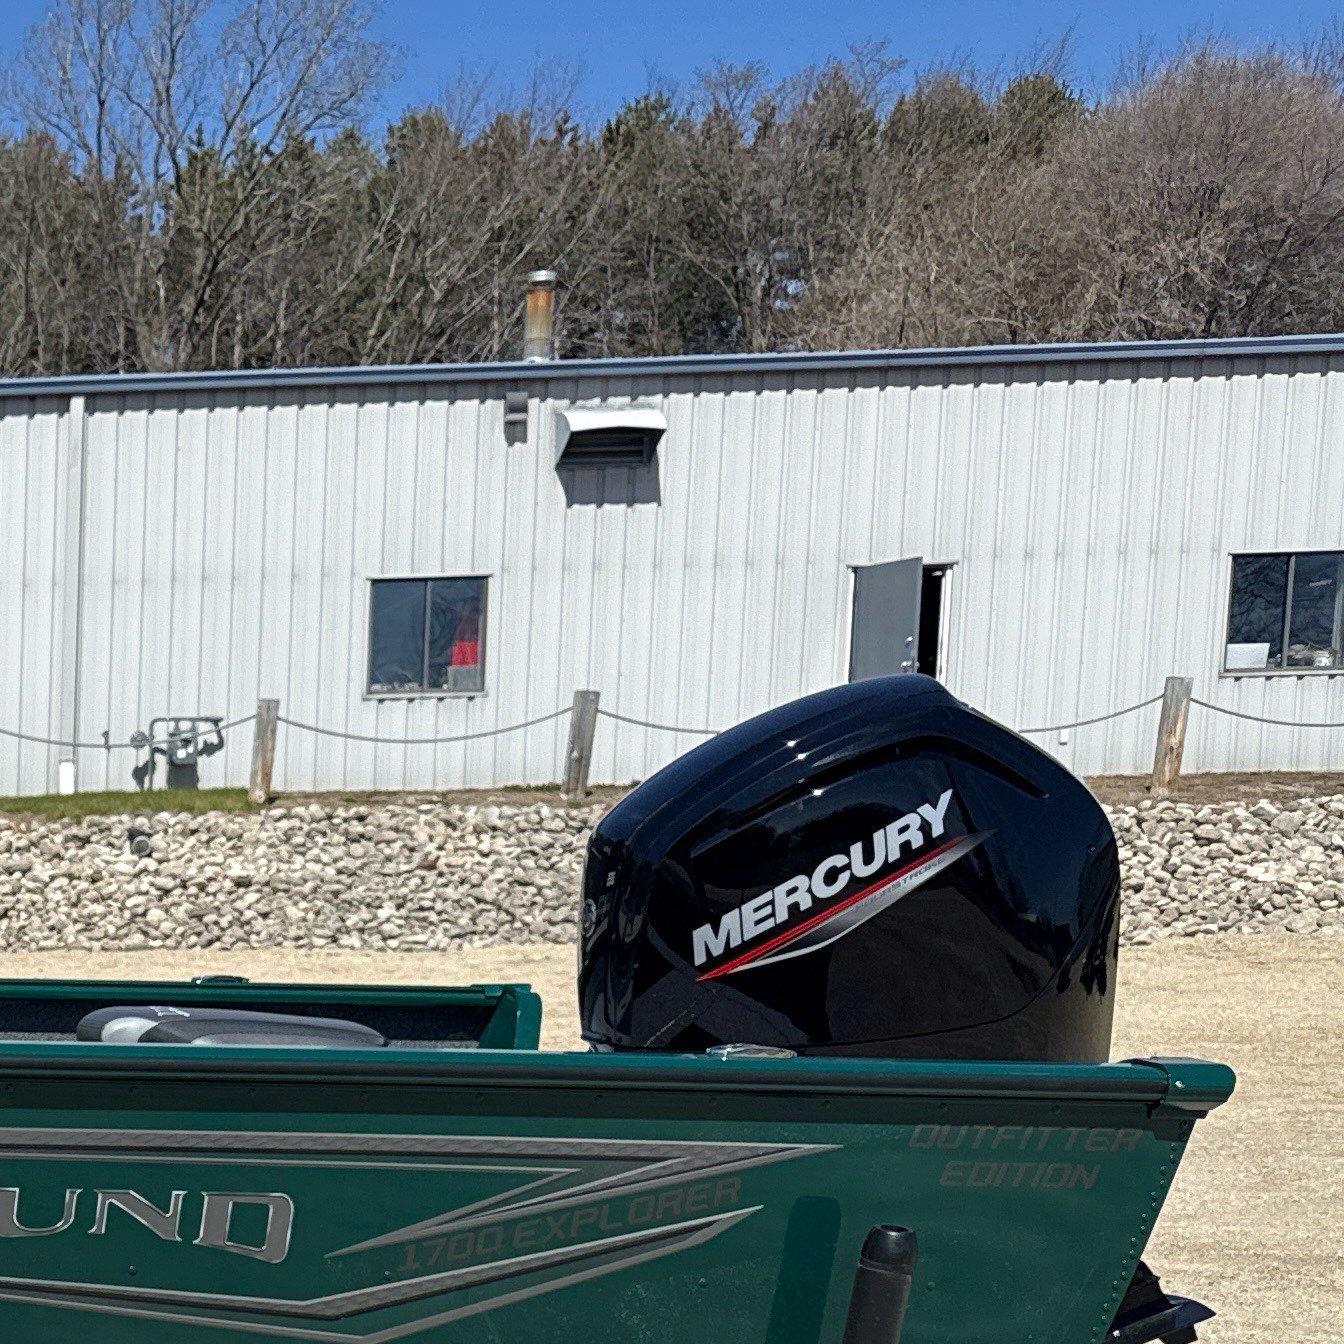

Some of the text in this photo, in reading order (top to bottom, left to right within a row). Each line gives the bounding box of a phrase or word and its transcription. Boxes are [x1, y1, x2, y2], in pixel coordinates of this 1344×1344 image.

[692, 788, 954, 967] MERCURY
[909, 1124, 1146, 1152] OUTFITTER
[939, 1160, 1101, 1190] EDITION
[399, 1177, 742, 1272] 1700 EXPLORER
